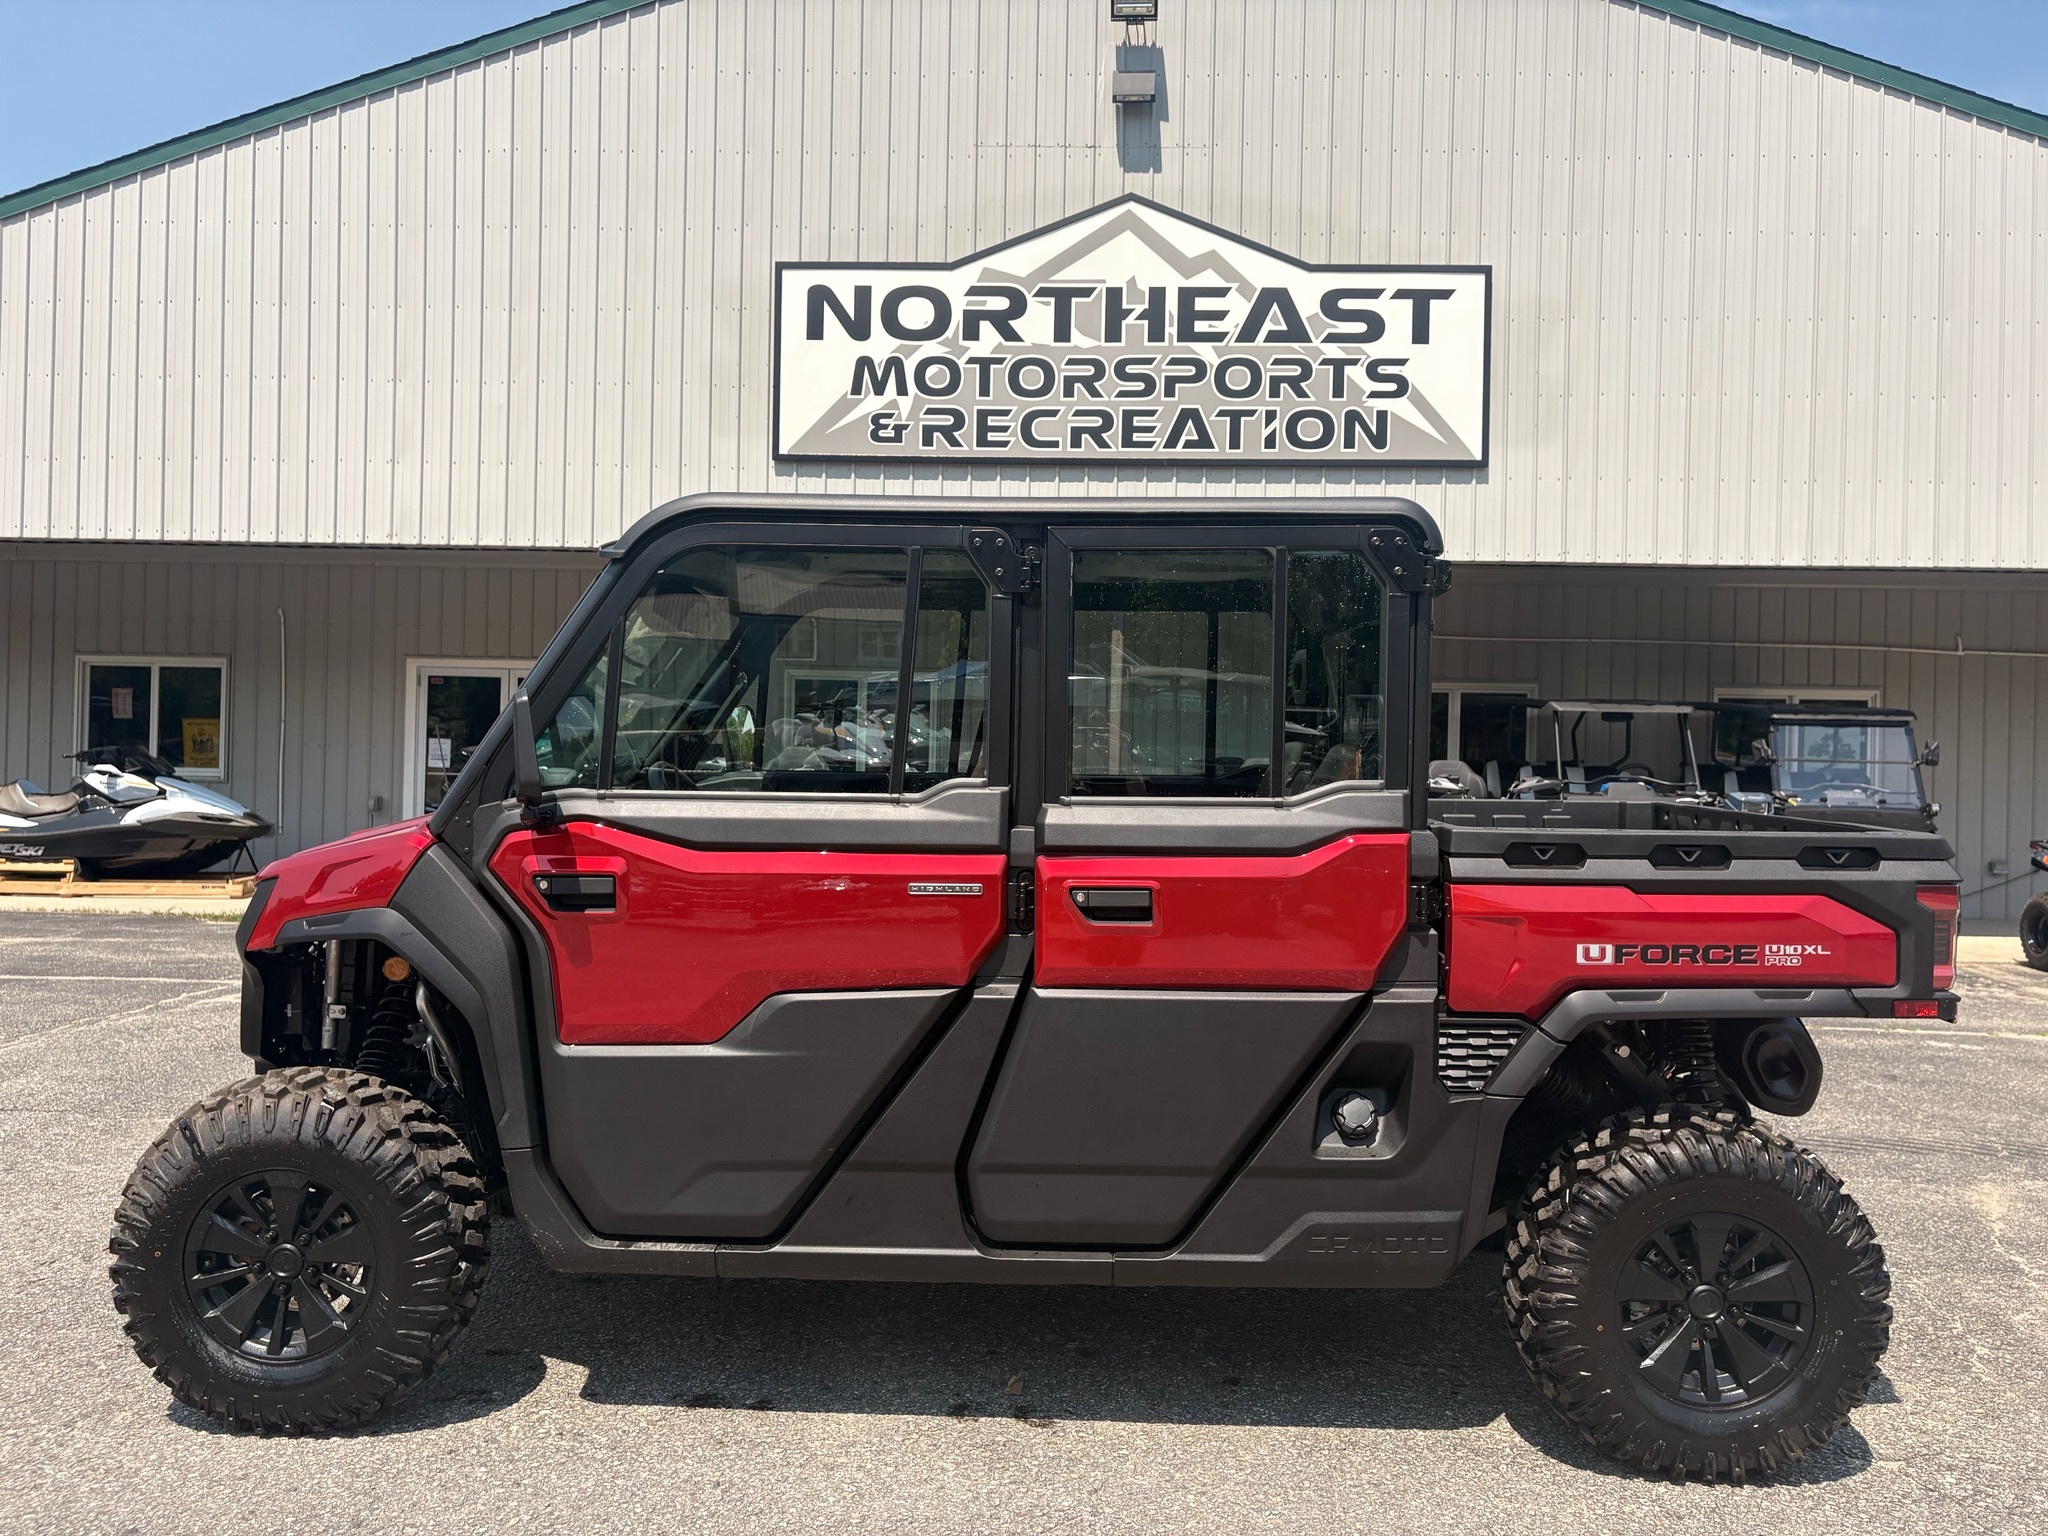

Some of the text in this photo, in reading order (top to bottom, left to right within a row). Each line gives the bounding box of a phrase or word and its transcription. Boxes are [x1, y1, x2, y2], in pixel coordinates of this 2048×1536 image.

[805, 284, 1457, 345] NORTHEAST
[849, 355, 1410, 400] MOTORSPORTS
[1765, 955, 1803, 966] PRO
[1308, 1235, 1449, 1254] CFMOTO
